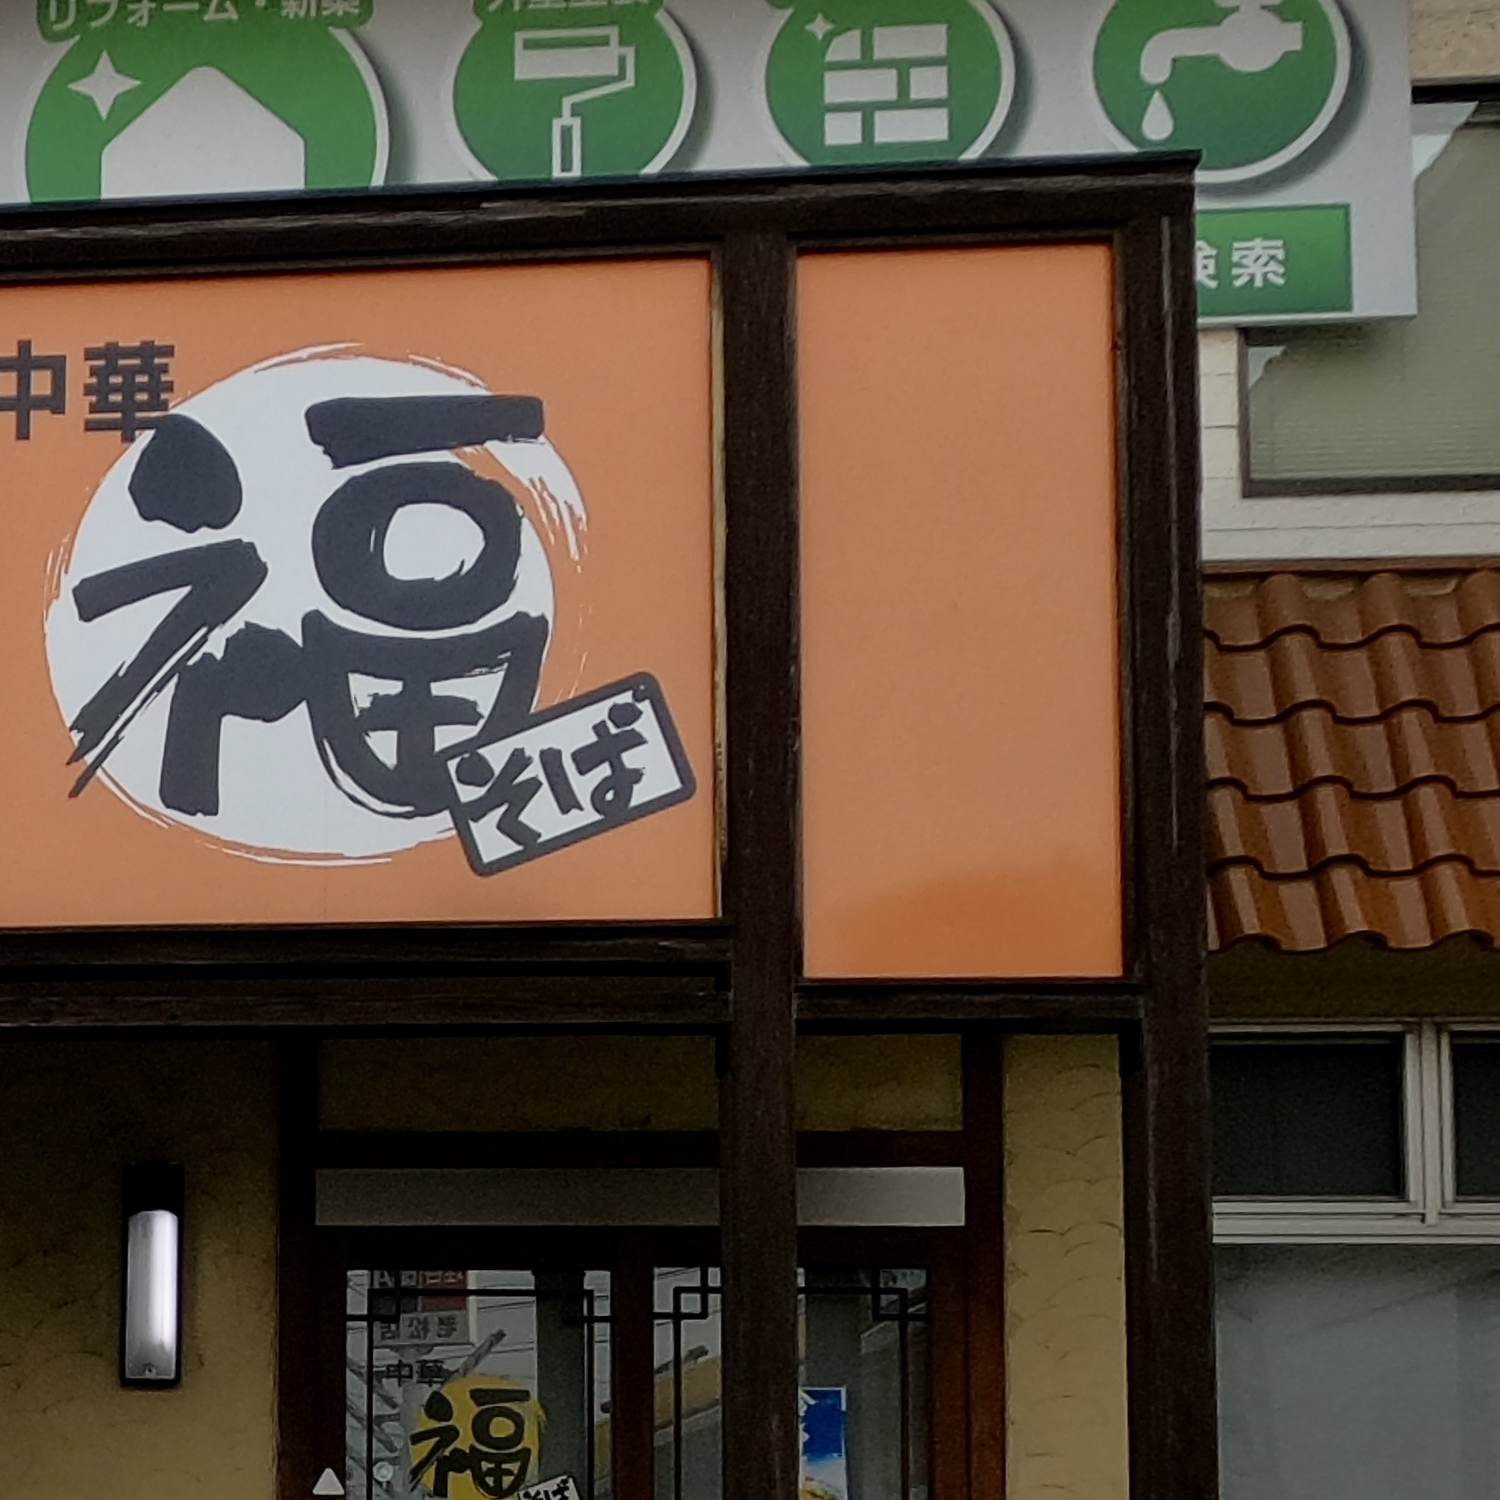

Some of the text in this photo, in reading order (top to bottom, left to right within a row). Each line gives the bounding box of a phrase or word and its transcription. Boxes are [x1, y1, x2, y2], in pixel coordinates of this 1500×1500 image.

[69, 394, 549, 817] 福
[456, 700, 645, 849] そば
[409, 1388, 531, 1500] 福
